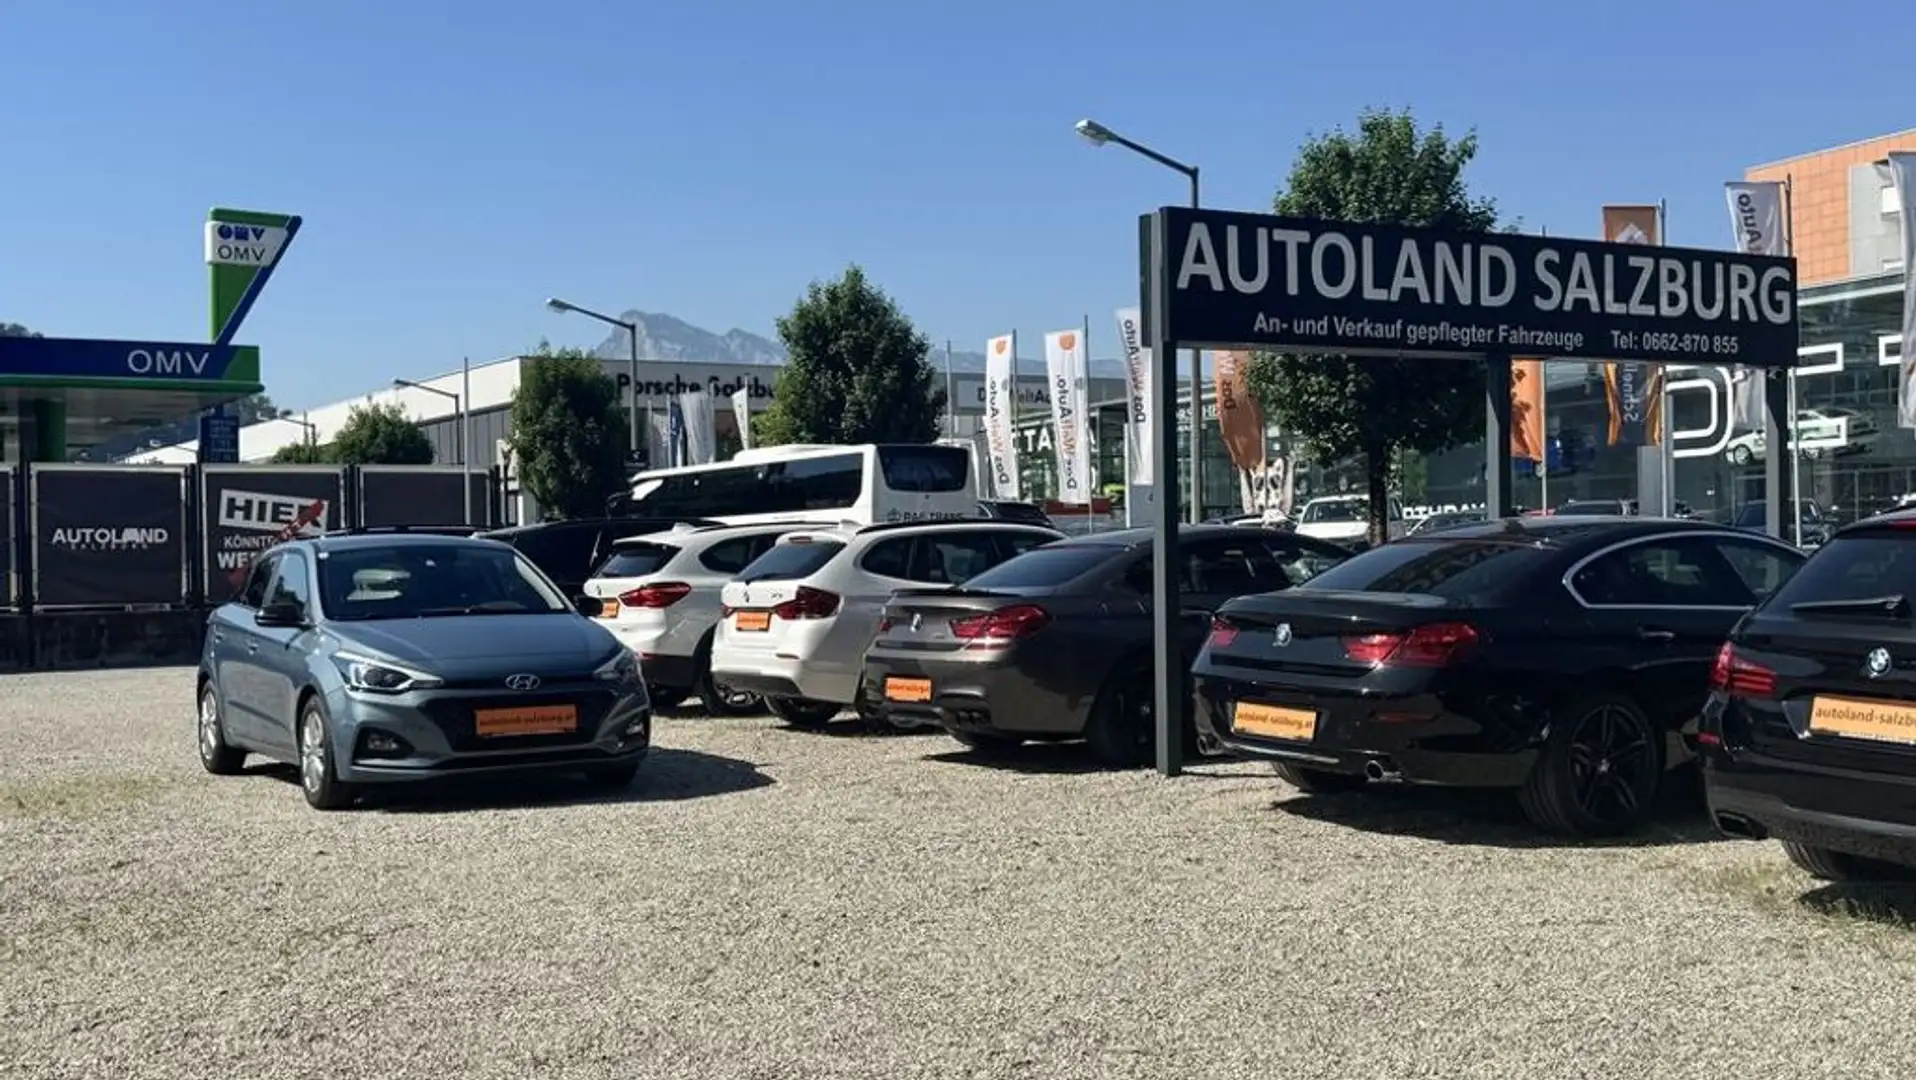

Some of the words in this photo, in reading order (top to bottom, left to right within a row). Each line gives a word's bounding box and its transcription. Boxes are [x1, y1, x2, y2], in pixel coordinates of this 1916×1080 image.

[217, 244, 266, 261] OMV
[1176, 221, 1517, 308] AUTOLAND
[1533, 246, 1793, 325] SALZBURG
[1253, 311, 1288, 334] An-
[1293, 315, 1329, 336] und
[1332, 315, 1403, 339] Verkauf
[1406, 321, 1494, 347] gepflegter
[1498, 323, 1584, 352] Fahrzeuge
[1609, 329, 1639, 350] Tel:
[1642, 331, 1710, 353] 0662-870
[1713, 335, 1739, 354] 855
[127, 349, 210, 374] OMV
[616, 373, 701, 395] Porsche
[52, 527, 168, 544] AUTOLAND
